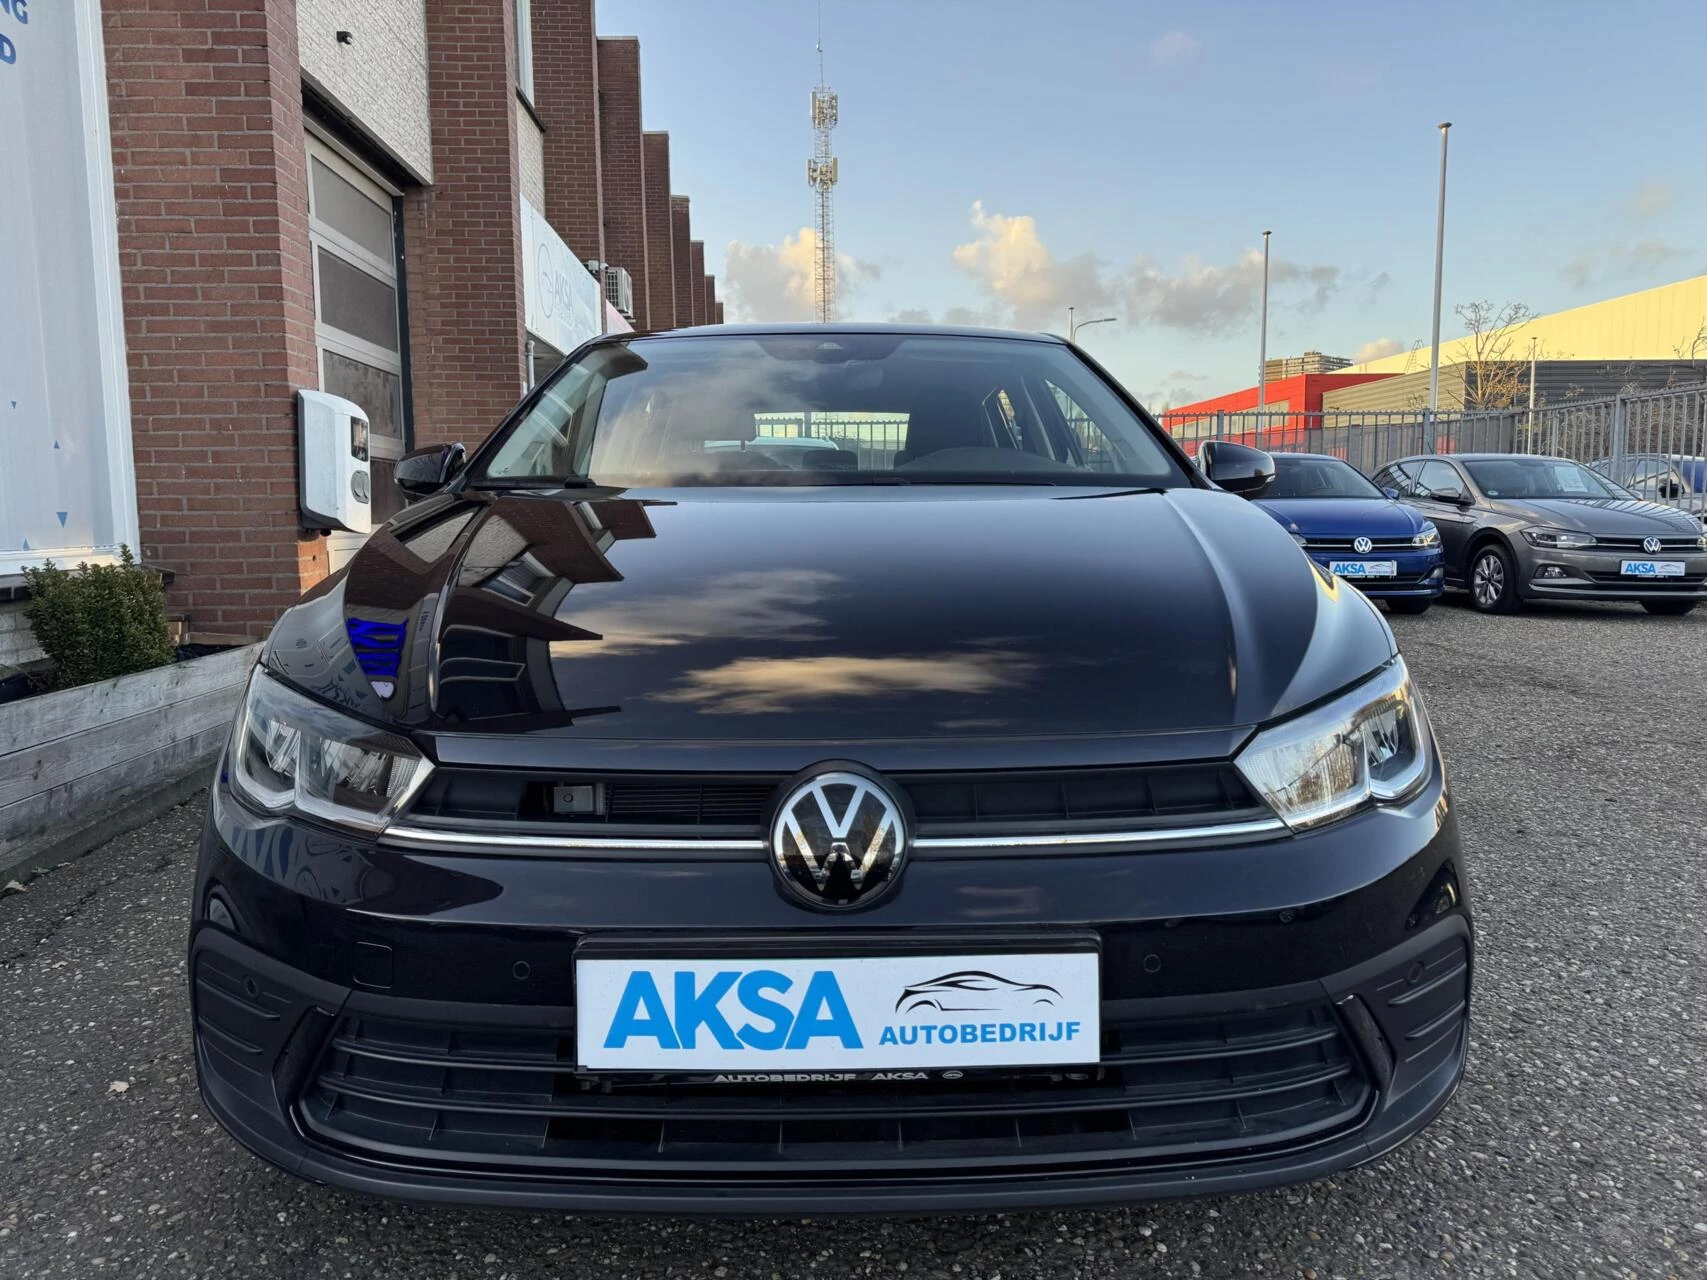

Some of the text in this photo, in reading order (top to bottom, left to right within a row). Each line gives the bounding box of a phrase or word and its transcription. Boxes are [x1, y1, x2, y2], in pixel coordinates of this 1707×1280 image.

[1333, 563, 1366, 575] AKSA
[1625, 563, 1656, 574] AKSA
[602, 970, 864, 1051] AKSA
[878, 1021, 1081, 1046] AUTOBEDRIJF
[713, 1072, 929, 1083] AUTOBEDRIJF AKSA
